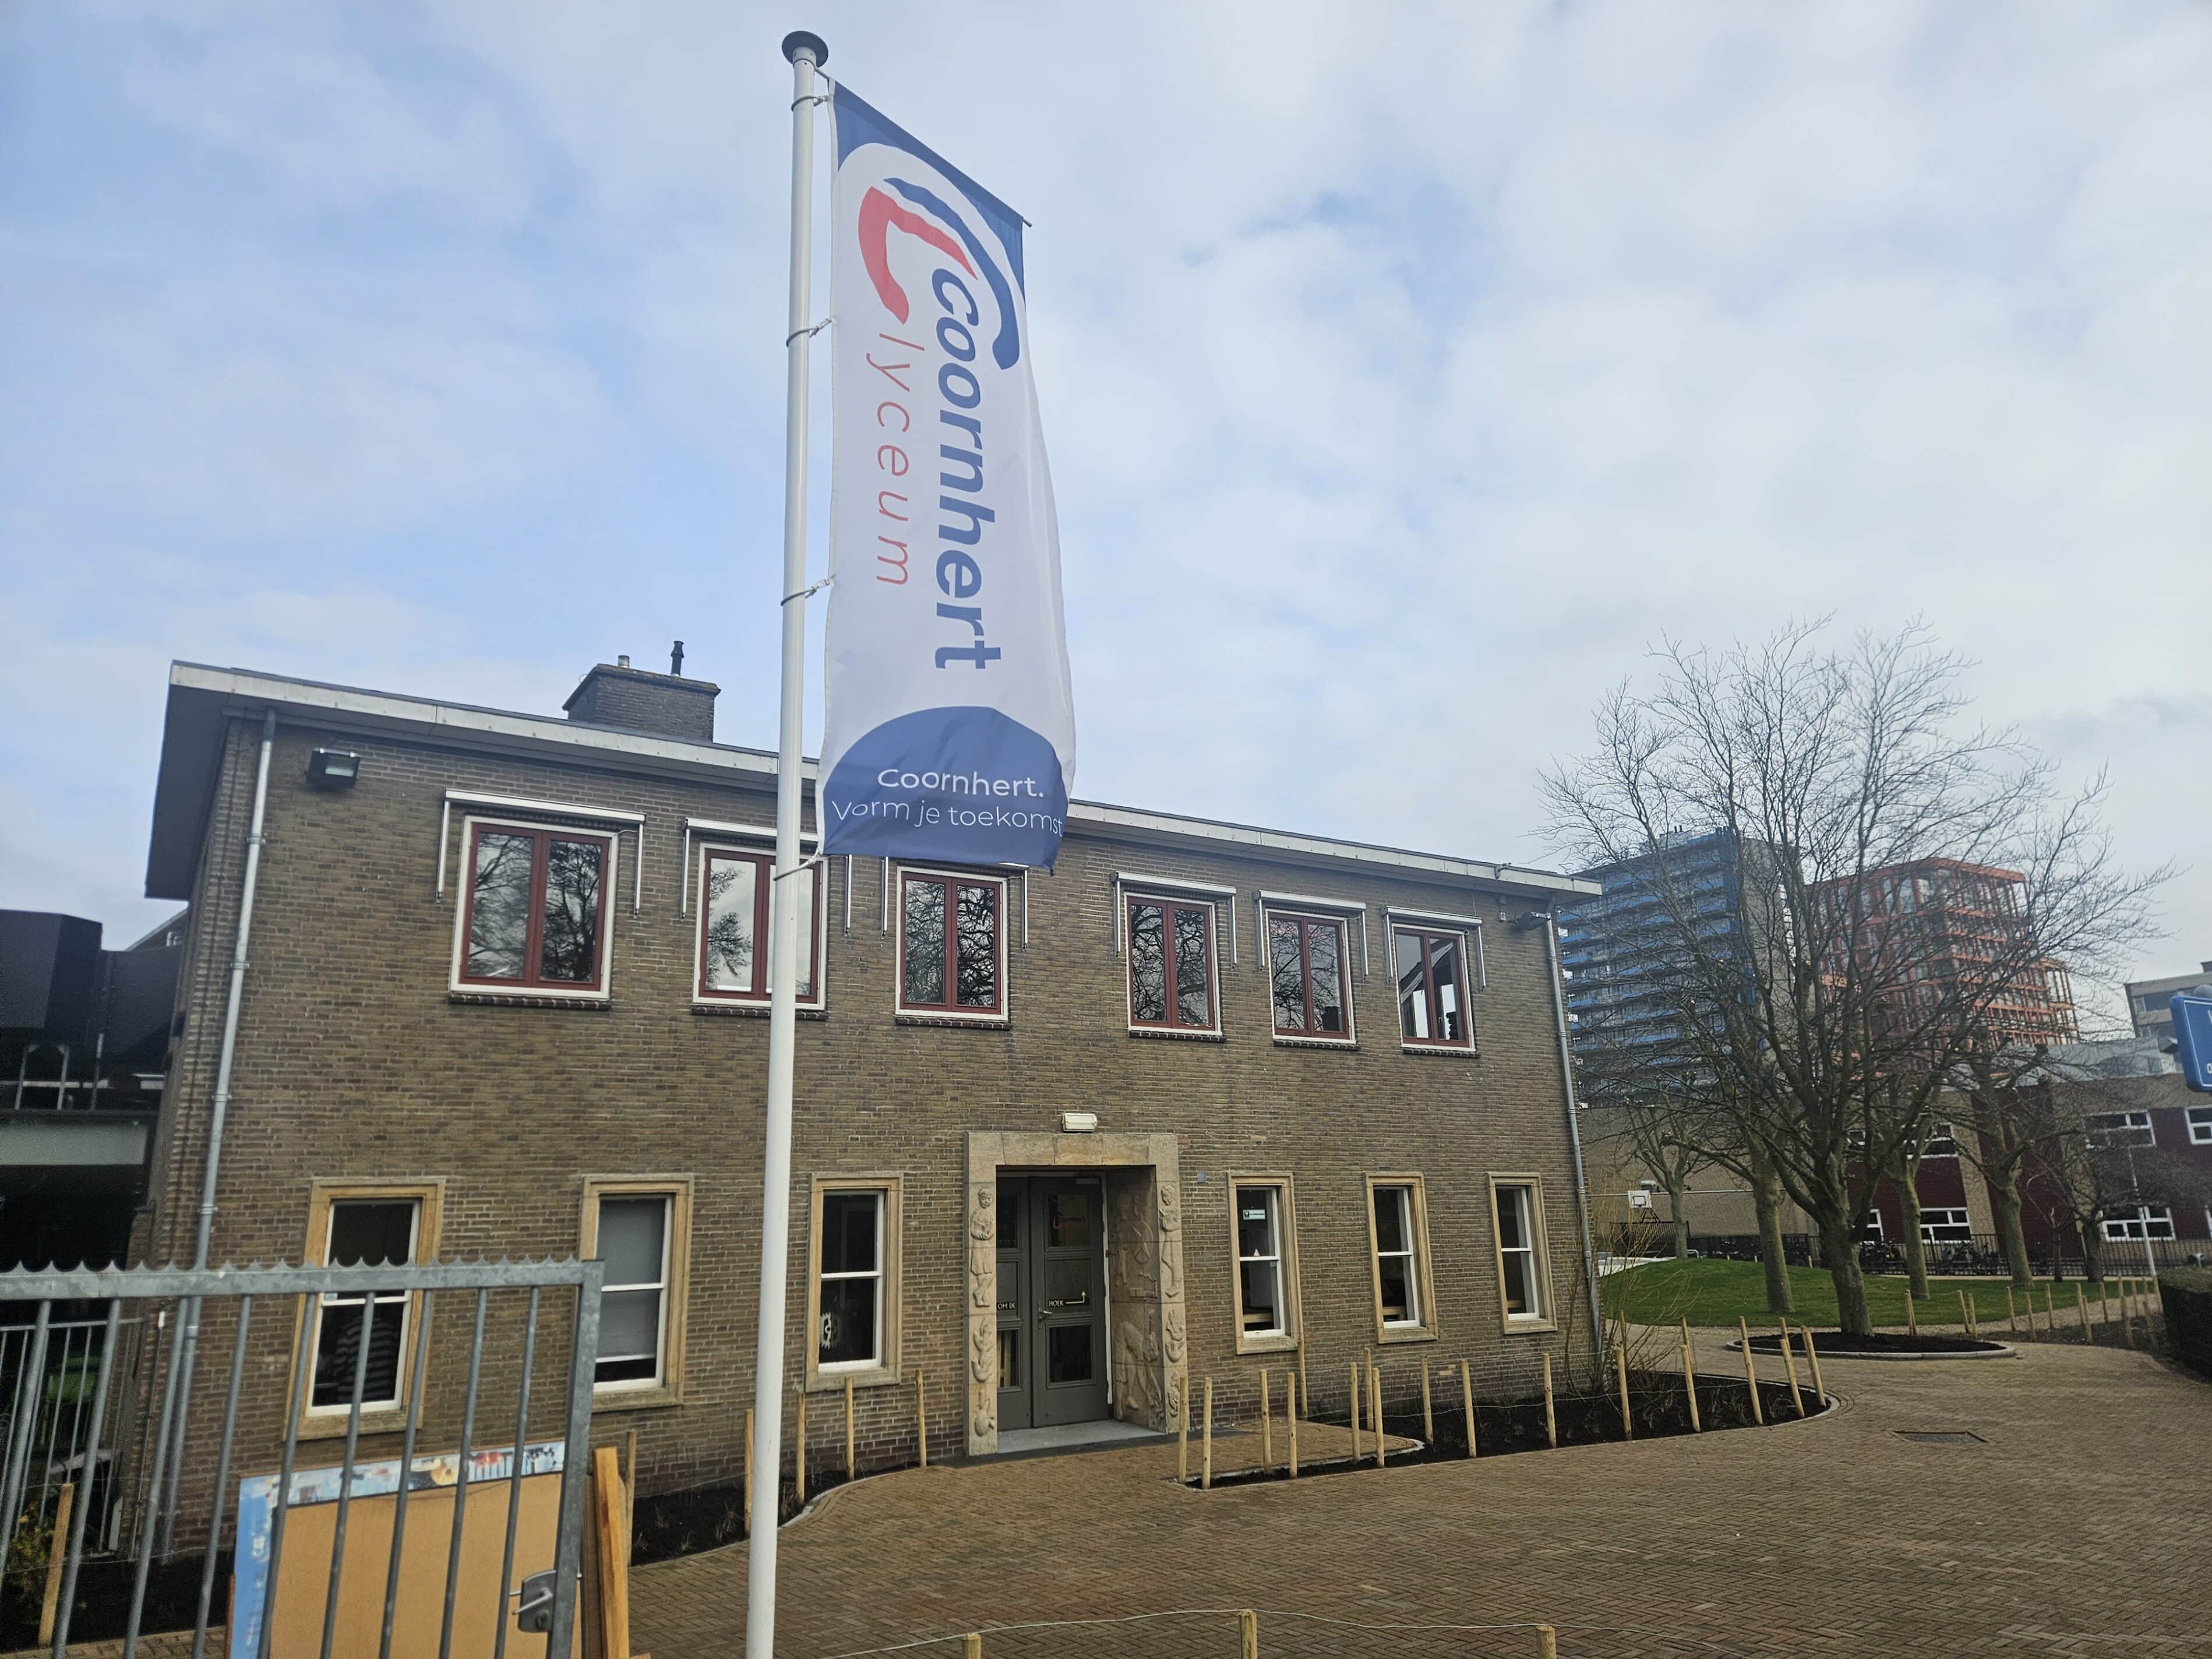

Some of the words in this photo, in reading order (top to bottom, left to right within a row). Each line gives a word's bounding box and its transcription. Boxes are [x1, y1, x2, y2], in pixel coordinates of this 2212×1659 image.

[867, 334, 924, 584] lyceum
[877, 769, 1043, 797] Coornhert.
[831, 801, 909, 821] Vorm
[914, 800, 940, 828] je
[948, 806, 1063, 837] toekomst
